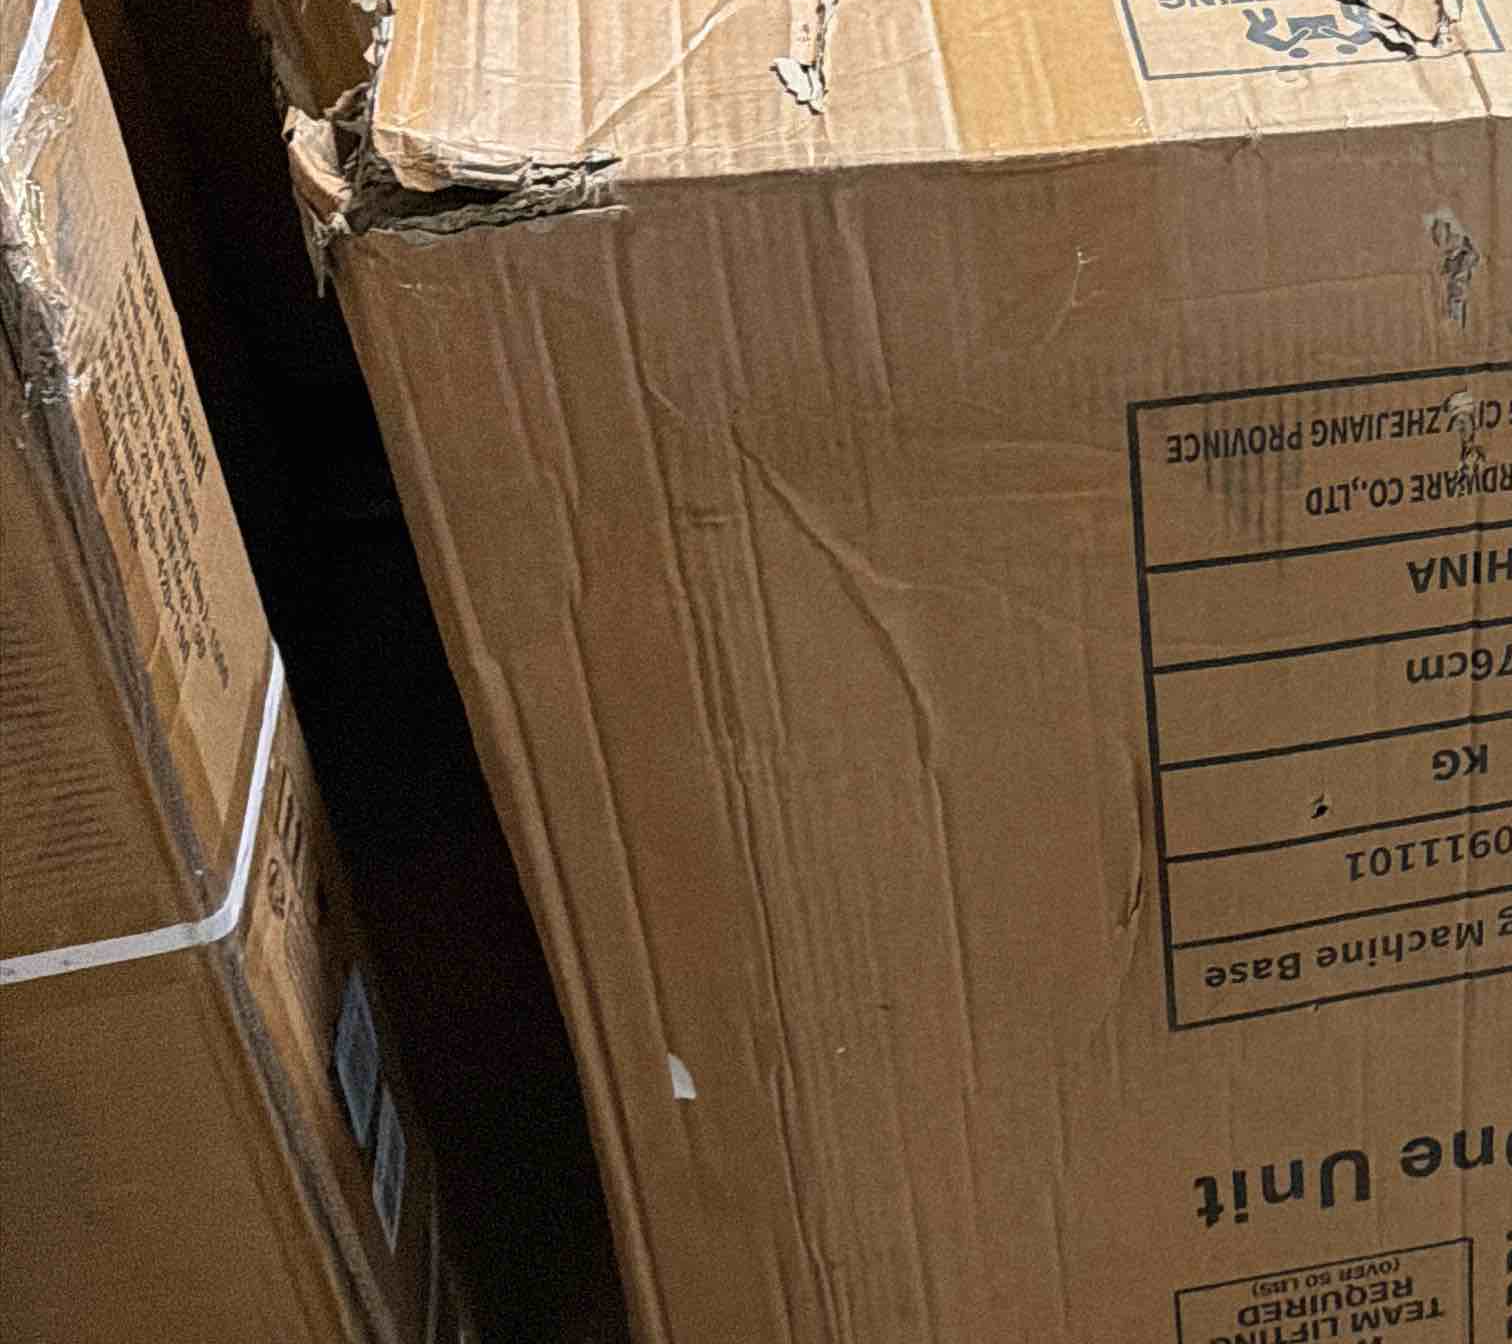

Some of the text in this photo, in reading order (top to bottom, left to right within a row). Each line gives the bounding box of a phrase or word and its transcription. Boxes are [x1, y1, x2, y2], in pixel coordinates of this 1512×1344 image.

[1166, 421, 1302, 464] PROVINCE
[1305, 476, 1402, 516] CO.,LTD
[1431, 743, 1490, 782] KG
[1316, 918, 1484, 966] Machine
[1204, 954, 1300, 992] Base
[1193, 1149, 1372, 1229] Unit
[1252, 1258, 1400, 1296] (OVER 50 LBS)
[1237, 1277, 1413, 1327] REQUIRED
[1351, 1297, 1444, 1332] TEAM
